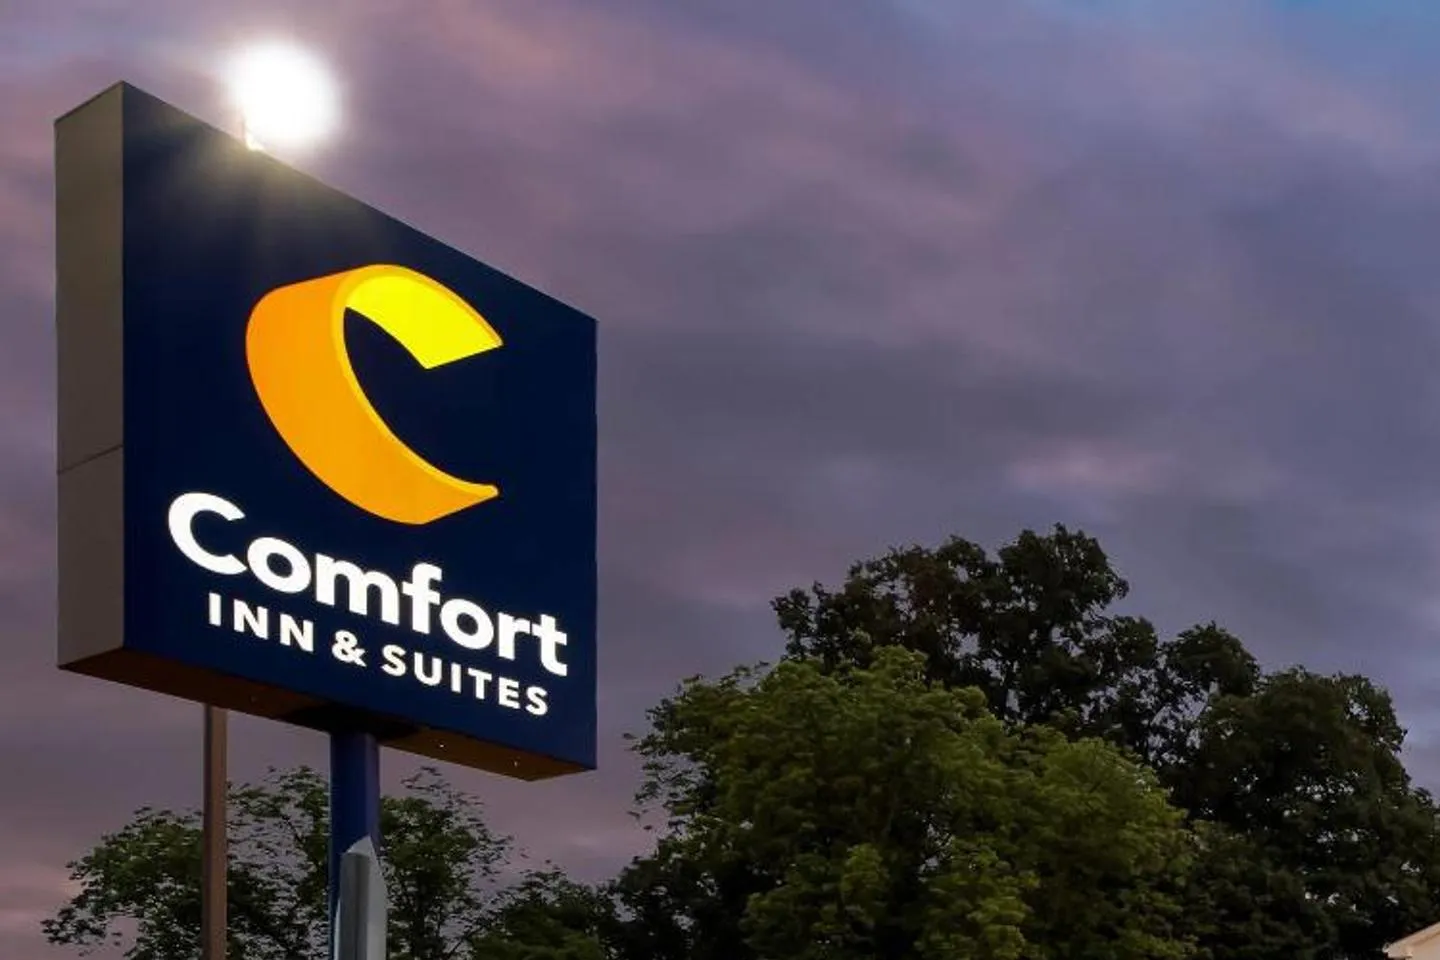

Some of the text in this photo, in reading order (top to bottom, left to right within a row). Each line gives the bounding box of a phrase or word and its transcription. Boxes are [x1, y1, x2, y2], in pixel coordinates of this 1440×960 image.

[168, 492, 568, 677] Comfort
[207, 592, 549, 717] INN & SUITES
